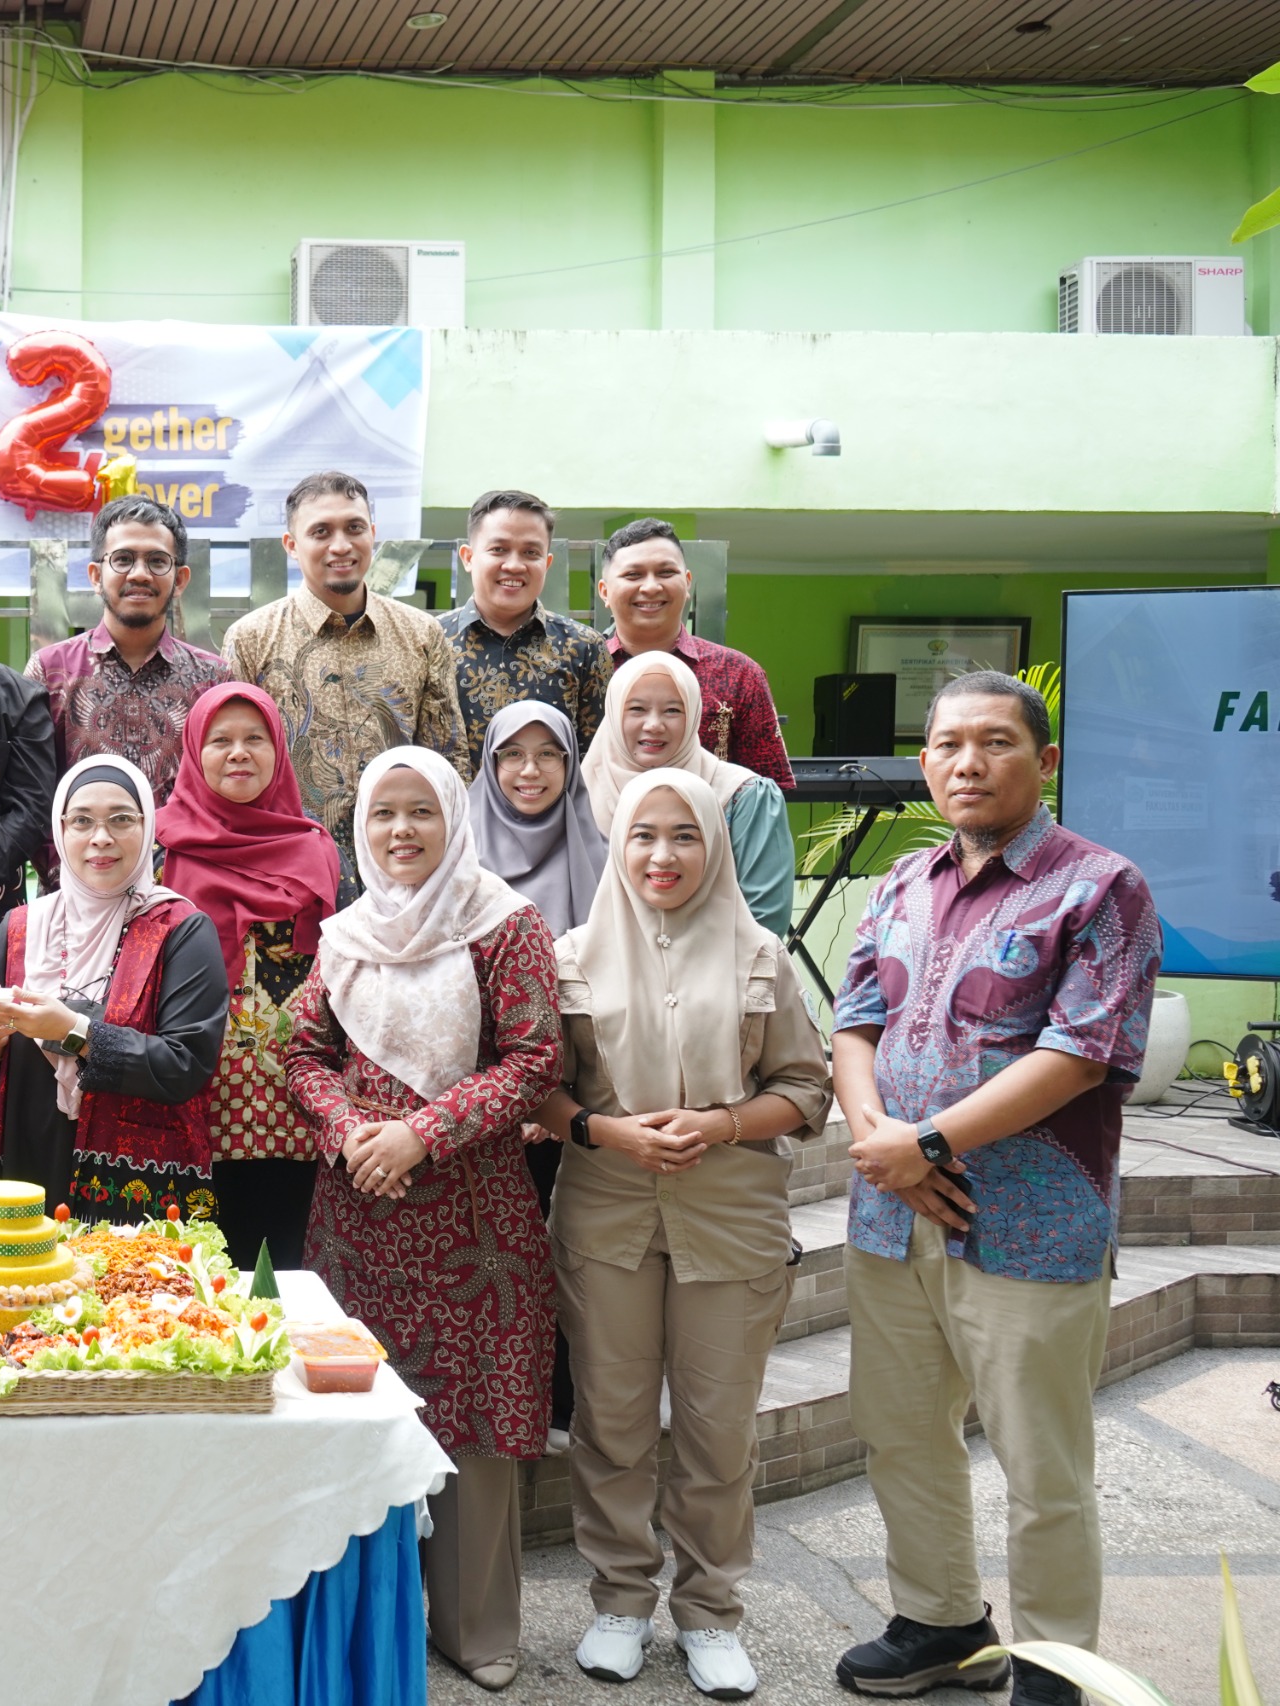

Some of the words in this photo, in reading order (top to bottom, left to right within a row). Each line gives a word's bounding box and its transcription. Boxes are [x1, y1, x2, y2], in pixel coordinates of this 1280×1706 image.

[1198, 267, 1243, 276] SHARP
[103, 407, 233, 457] gether
[1213, 691, 1280, 732] FA
